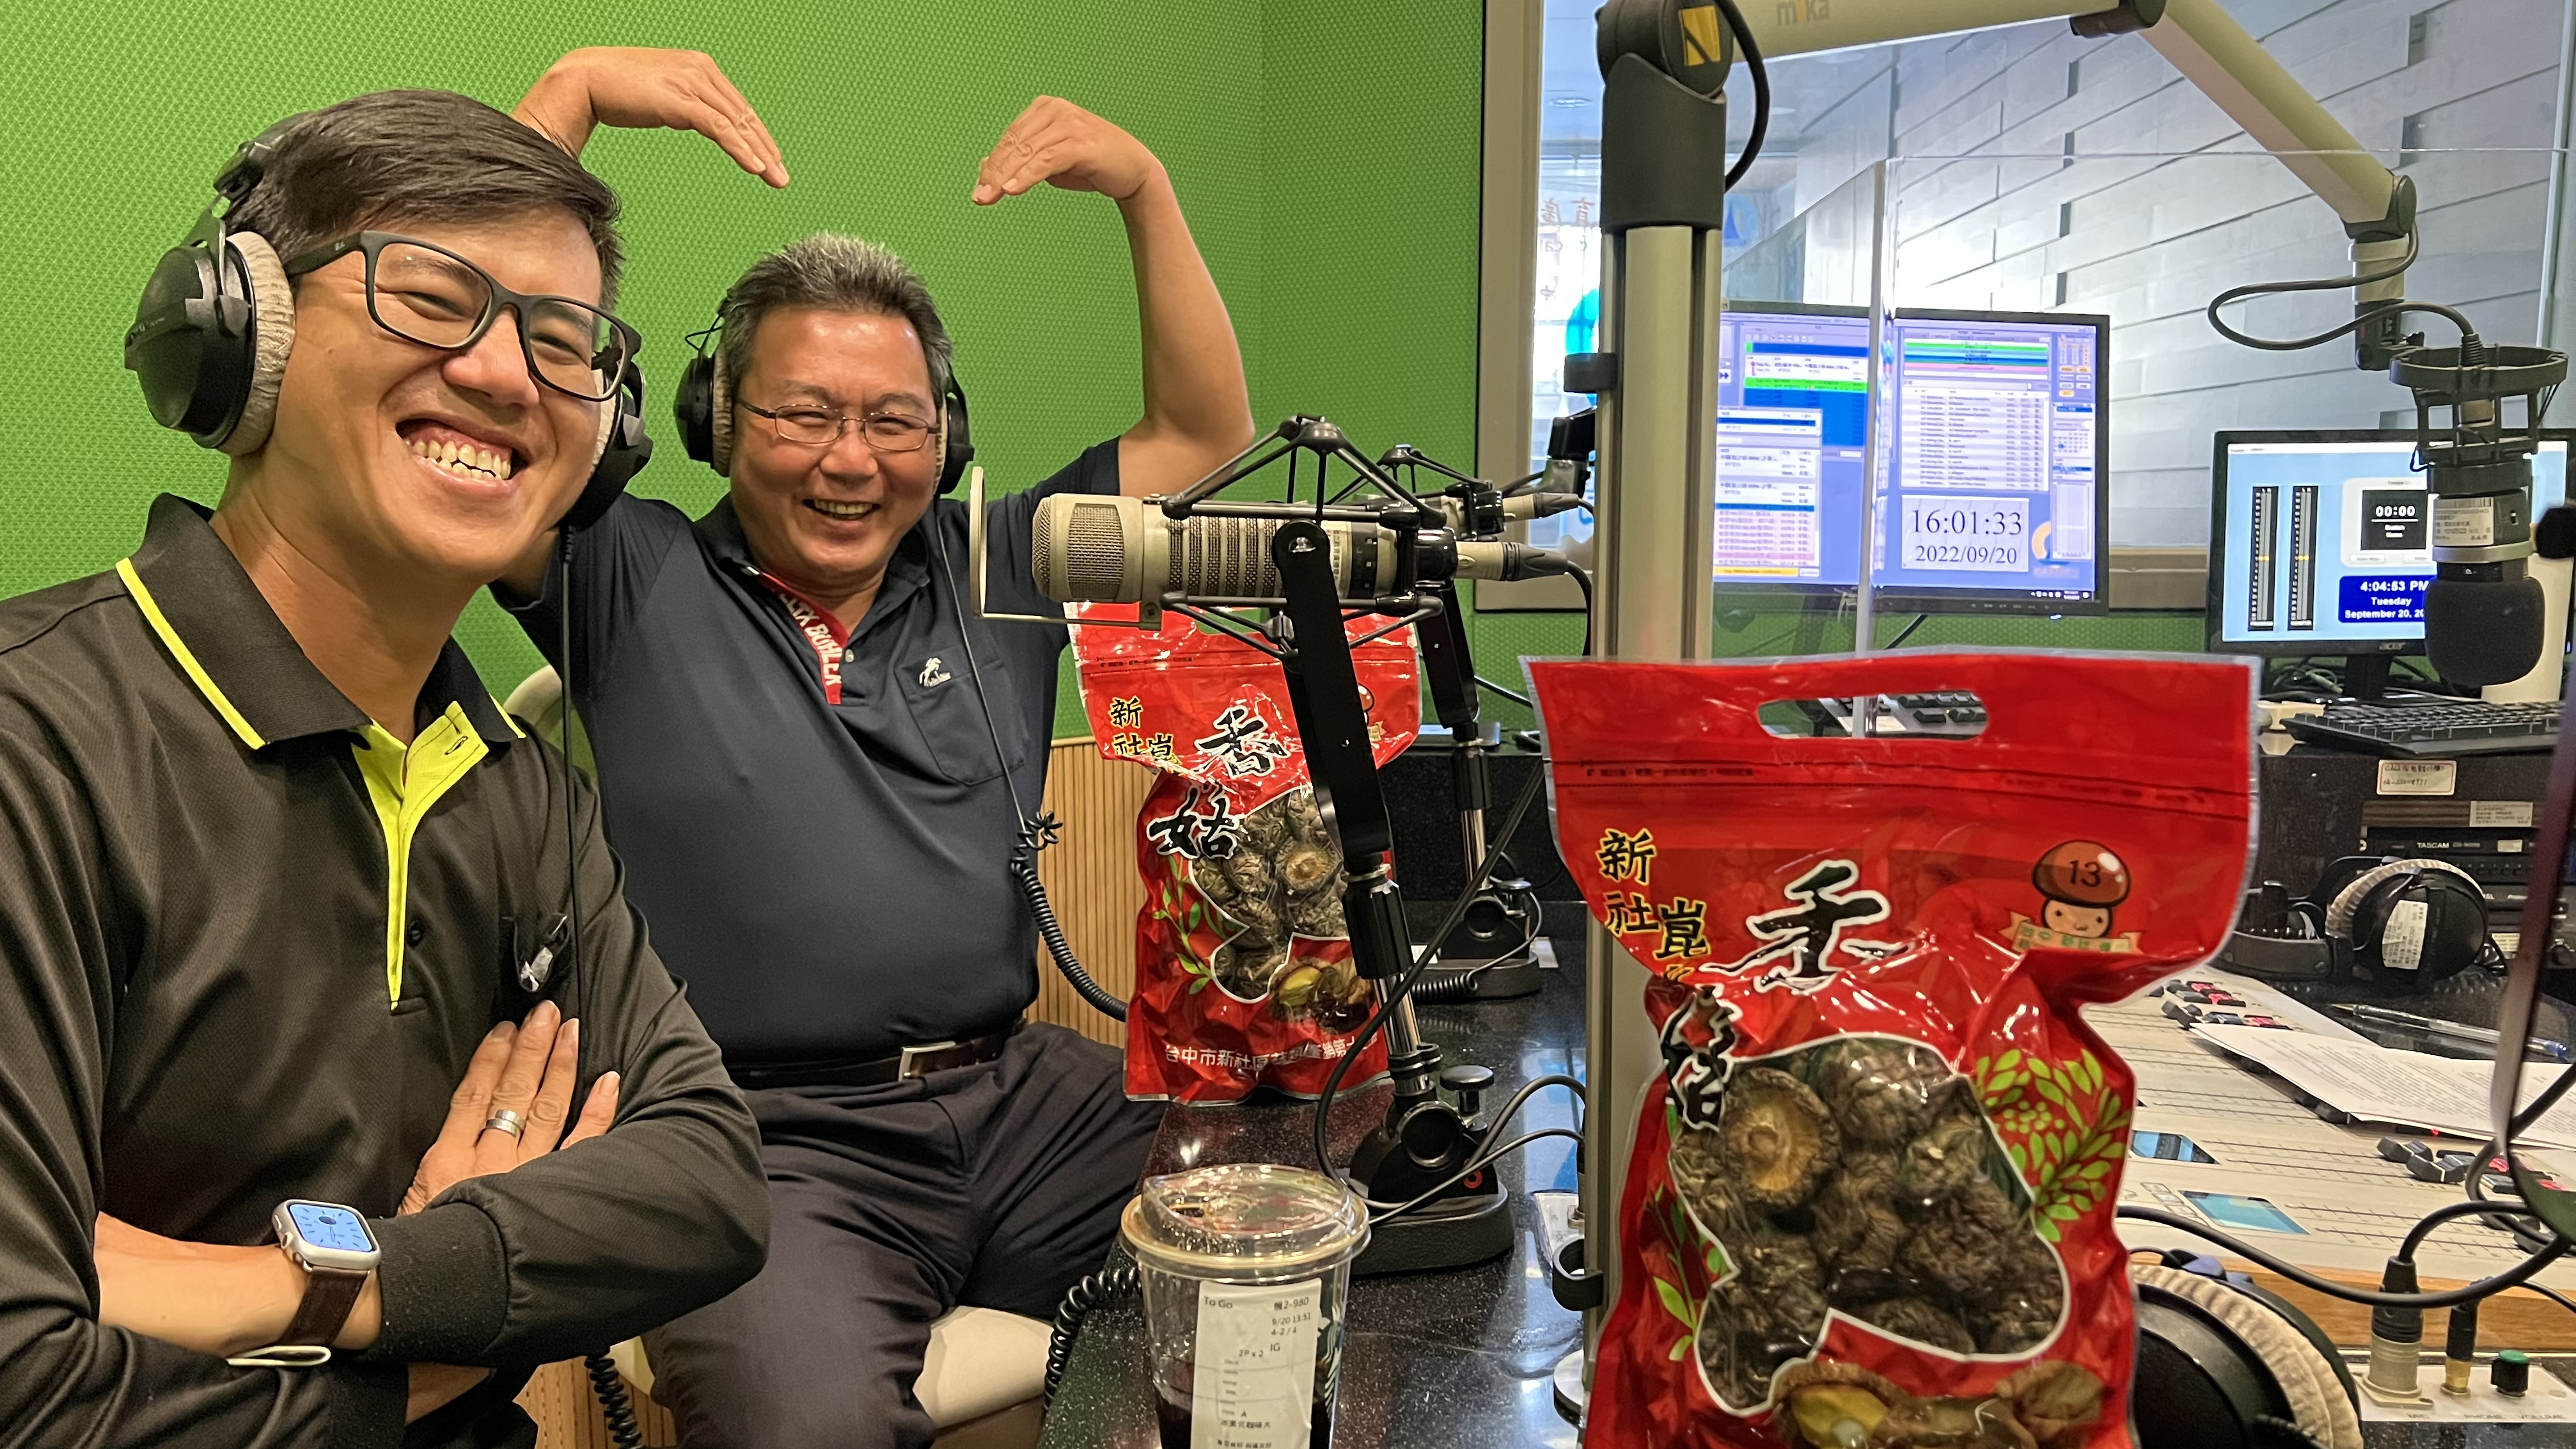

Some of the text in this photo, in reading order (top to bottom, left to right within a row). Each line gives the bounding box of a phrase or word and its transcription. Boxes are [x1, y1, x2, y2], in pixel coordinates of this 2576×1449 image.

[2375, 505, 2415, 517] 00:00
[1912, 509, 2022, 535] 16:01:33
[1915, 545, 2018, 564] 2022/09/20
[2360, 581, 2406, 592] 4:04:53
[2371, 596, 2412, 606] Tuesday
[2344, 609, 2396, 620] September
[2069, 860, 2101, 887] 13
[1204, 1295, 1234, 1309] To Go
